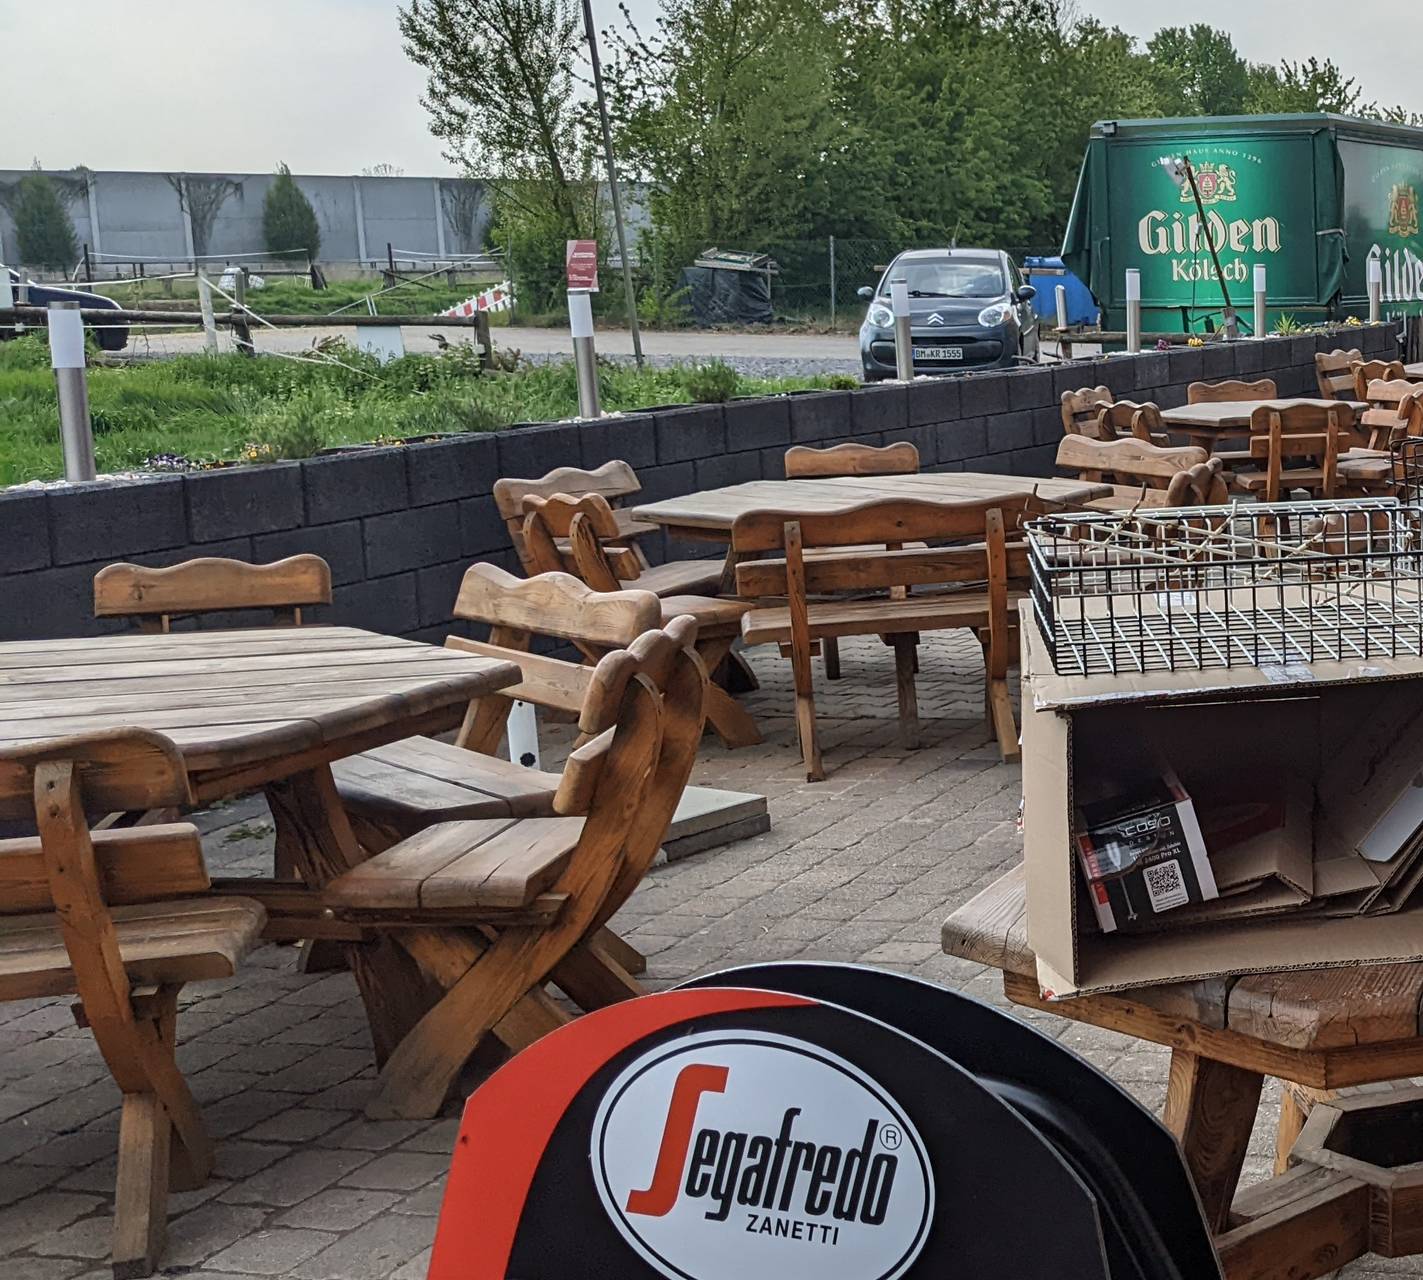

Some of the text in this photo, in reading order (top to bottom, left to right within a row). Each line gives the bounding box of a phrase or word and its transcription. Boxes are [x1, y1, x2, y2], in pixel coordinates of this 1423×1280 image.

[1213, 147, 1239, 156] ANNO
[1138, 209, 1281, 255] Gilden
[1171, 257, 1249, 284] Kölsch
[915, 349, 962, 358] BM KR 1555
[625, 1063, 899, 1226] Segafredo
[745, 1213, 840, 1246] ZANETTI
